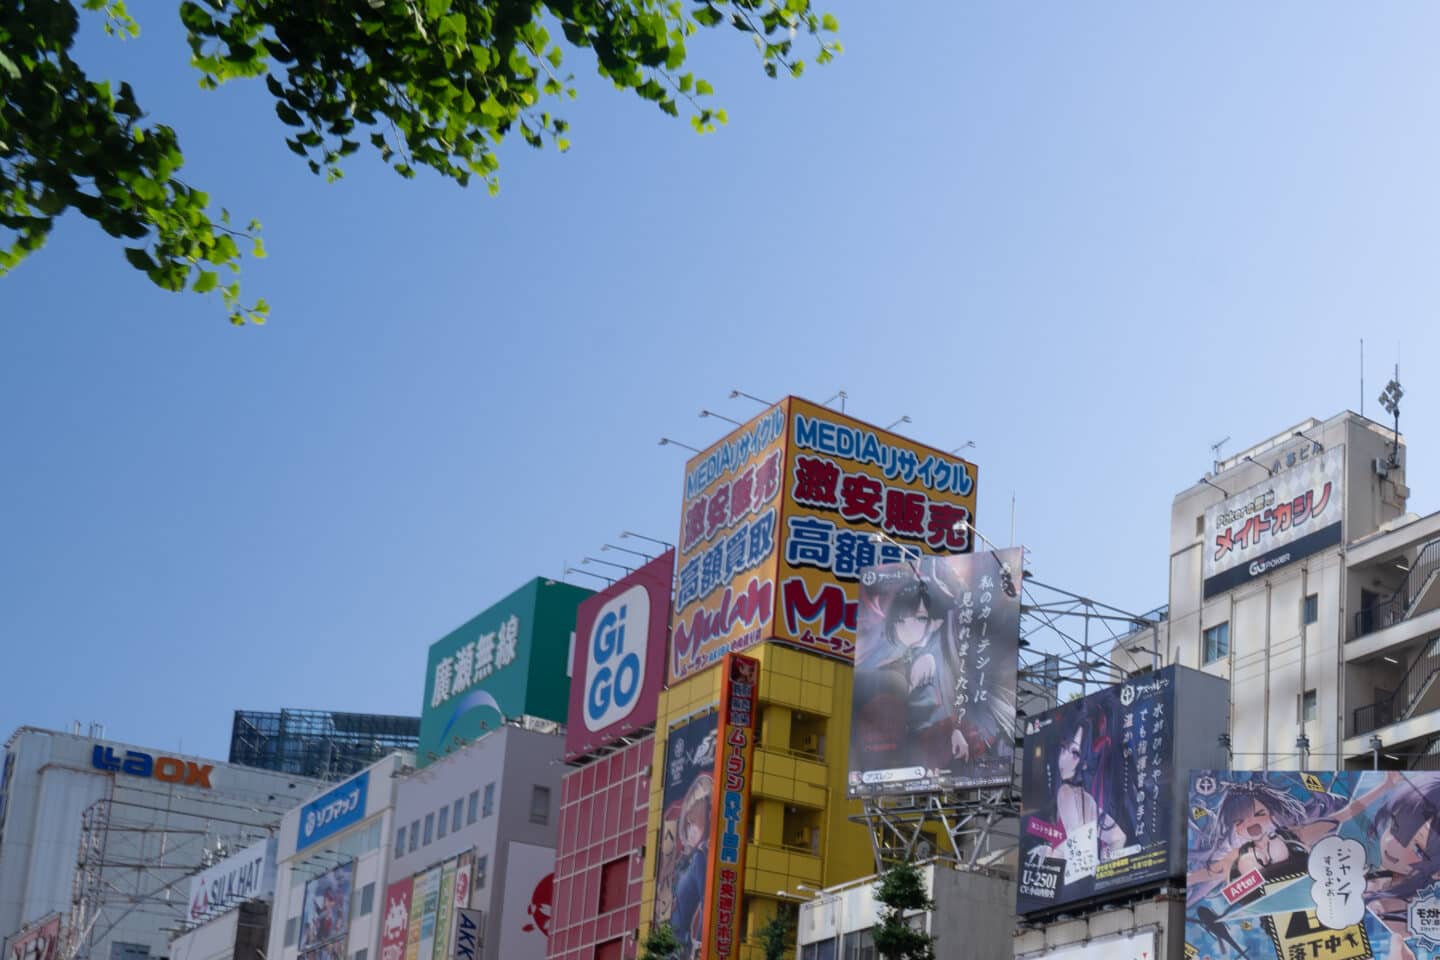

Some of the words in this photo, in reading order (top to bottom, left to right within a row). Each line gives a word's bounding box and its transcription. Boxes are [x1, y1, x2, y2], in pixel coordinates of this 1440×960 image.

[686, 405, 785, 500] MEDIAリサイクル
[795, 414, 973, 495] MEDIAリサイクル
[682, 448, 781, 553] 激安販売
[793, 455, 967, 548] 激安販売
[1214, 481, 1332, 562] メイドカジノ
[676, 507, 775, 614] 高額買取
[431, 614, 520, 709] 廣瀬無線
[594, 604, 627, 665] Gi
[674, 576, 774, 678] Mulan
[588, 653, 640, 720] GO
[91, 745, 215, 789] Laox
[316, 788, 360, 826] ソフマップ
[239, 856, 262, 890] HAT
[1231, 875, 1257, 897] After
[1337, 849, 1350, 905] ジャンプ
